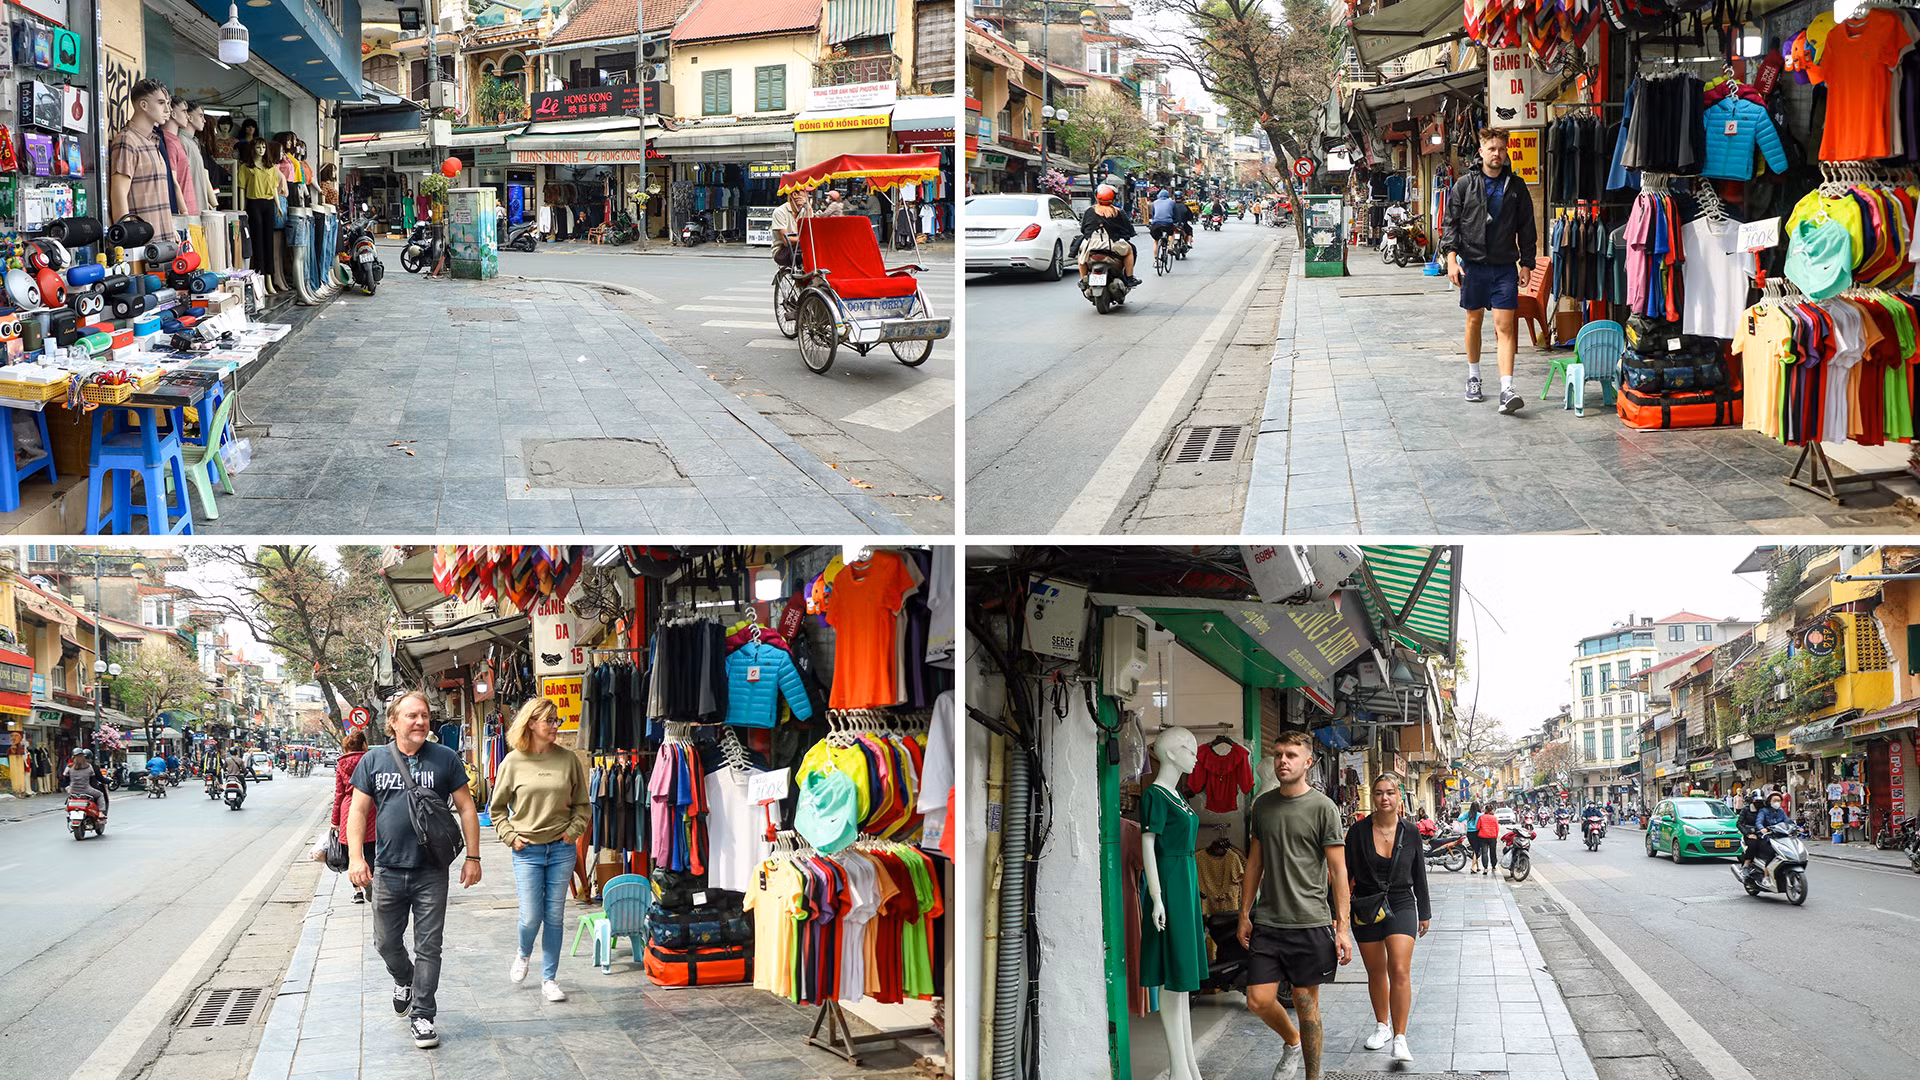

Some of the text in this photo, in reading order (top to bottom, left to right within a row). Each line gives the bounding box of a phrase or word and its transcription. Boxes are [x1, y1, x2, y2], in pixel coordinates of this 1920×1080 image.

[1493, 52, 1520, 71] GĂNG
[1510, 79, 1524, 95] DA
[536, 97, 560, 116] Lệ
[564, 94, 587, 105] HONG
[588, 92, 613, 103] KONG
[1525, 102, 1538, 119] 15
[861, 117, 885, 127] NGỌC
[1523, 137, 1537, 148] TAY
[601, 151, 621, 161] HONG
[621, 150, 641, 161] KONG
[1512, 150, 1523, 161] DA
[1522, 166, 1538, 175] 100%
[874, 299, 905, 310] WORRY
[1254, 546, 1277, 564] 698H
[1033, 596, 1055, 605] VNPT
[555, 624, 569, 640] DA
[1051, 635, 1075, 647] SERGE
[1315, 626, 1360, 667] ANH
[571, 647, 584, 665] 15
[545, 683, 567, 696] GĂNG
[559, 697, 570, 708] DA
